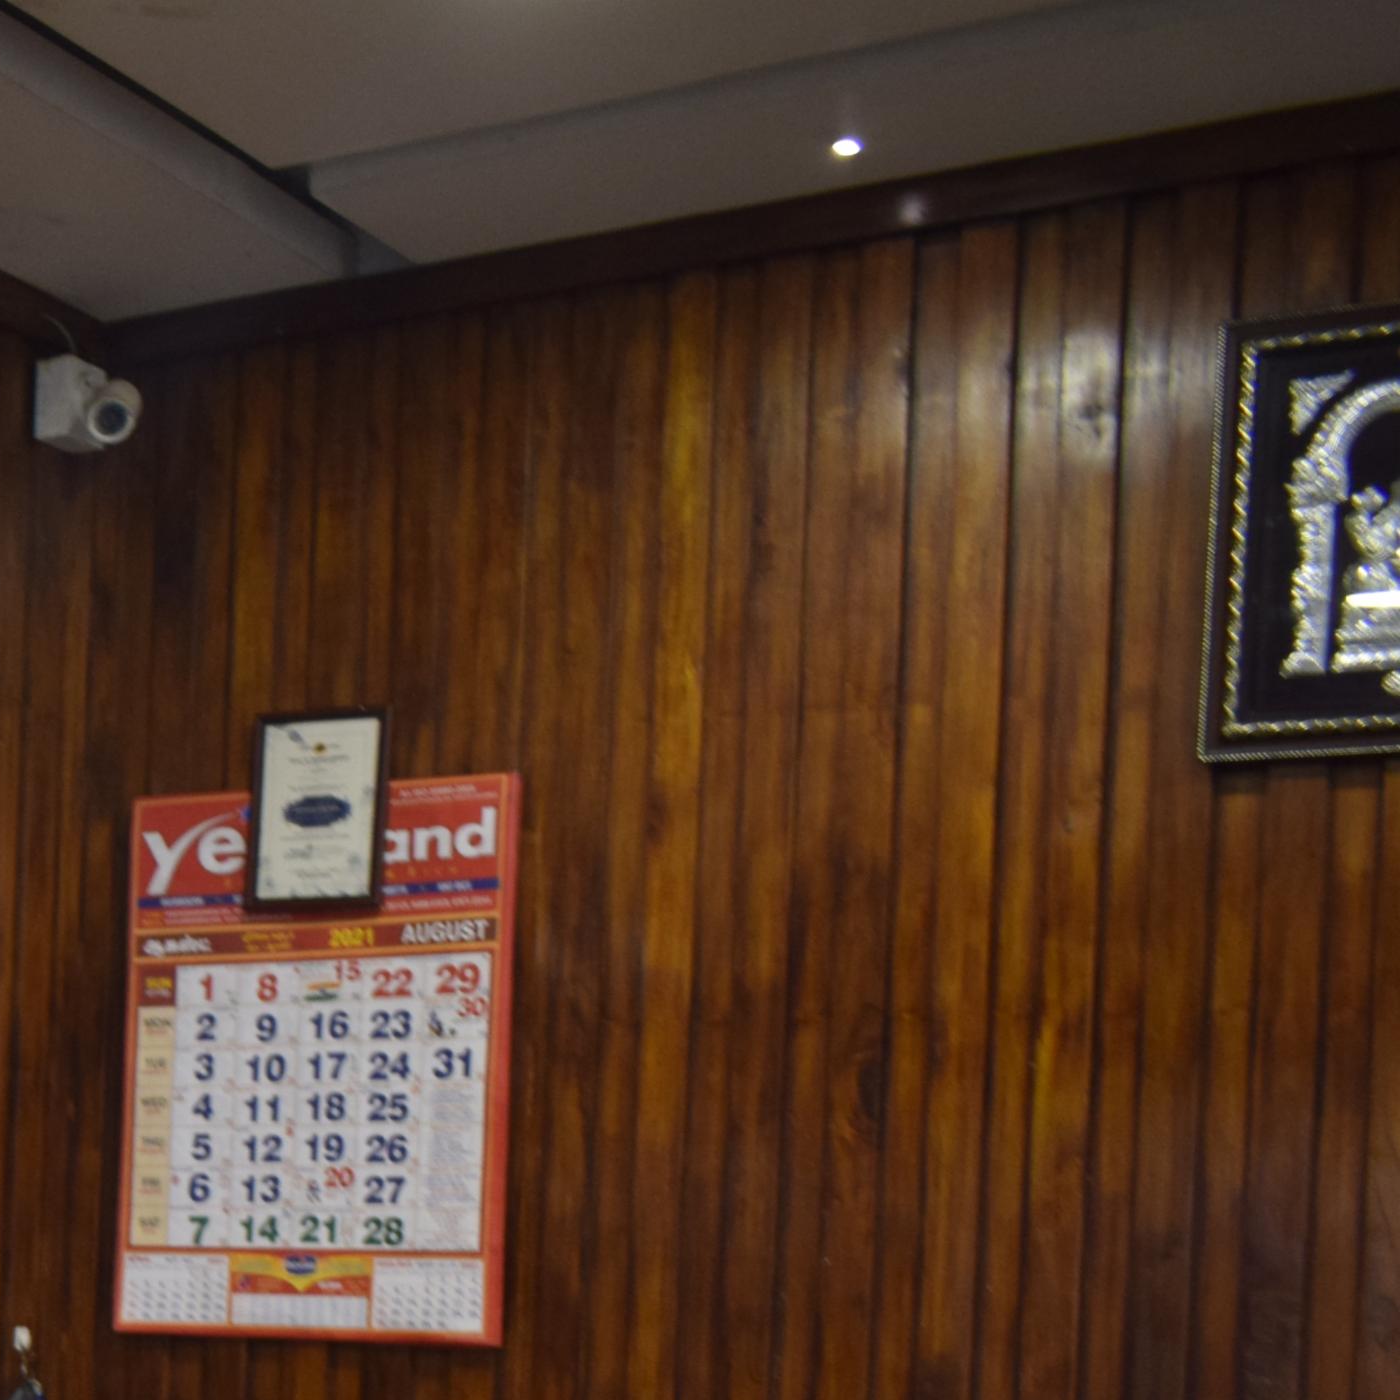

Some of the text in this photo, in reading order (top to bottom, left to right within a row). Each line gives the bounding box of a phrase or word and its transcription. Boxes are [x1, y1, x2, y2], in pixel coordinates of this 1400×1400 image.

[329, 927, 375, 948] 2021
[401, 918, 489, 945] AUGUST
[199, 973, 214, 1003] 1
[256, 972, 279, 1004] 8
[334, 957, 362, 981] 15
[372, 967, 414, 998] 22
[435, 961, 481, 994] 29
[196, 1012, 217, 1042] 2
[255, 1013, 278, 1043] 9
[309, 1009, 350, 1041] 16
[370, 1009, 413, 1040] 23
[455, 995, 489, 1018] 30
[193, 1052, 215, 1081] 3
[246, 1053, 287, 1082] 10
[307, 1051, 348, 1080] 17
[368, 1050, 412, 1081] 24
[432, 1046, 473, 1079] 31
[191, 1092, 214, 1121] 4
[244, 1094, 281, 1123] 11
[306, 1092, 347, 1122] 18
[367, 1092, 409, 1122] 25
[191, 1132, 212, 1161] 5
[243, 1134, 283, 1163] 12
[304, 1132, 345, 1162] 19
[365, 1133, 409, 1164] 26
[187, 1172, 212, 1203] 6
[241, 1174, 282, 1203] 13
[324, 1165, 356, 1189] 20
[364, 1175, 406, 1205] 27
[189, 1215, 210, 1245] 7
[240, 1214, 279, 1244] 14
[300, 1214, 338, 1244] 21
[362, 1215, 405, 1247] 28
